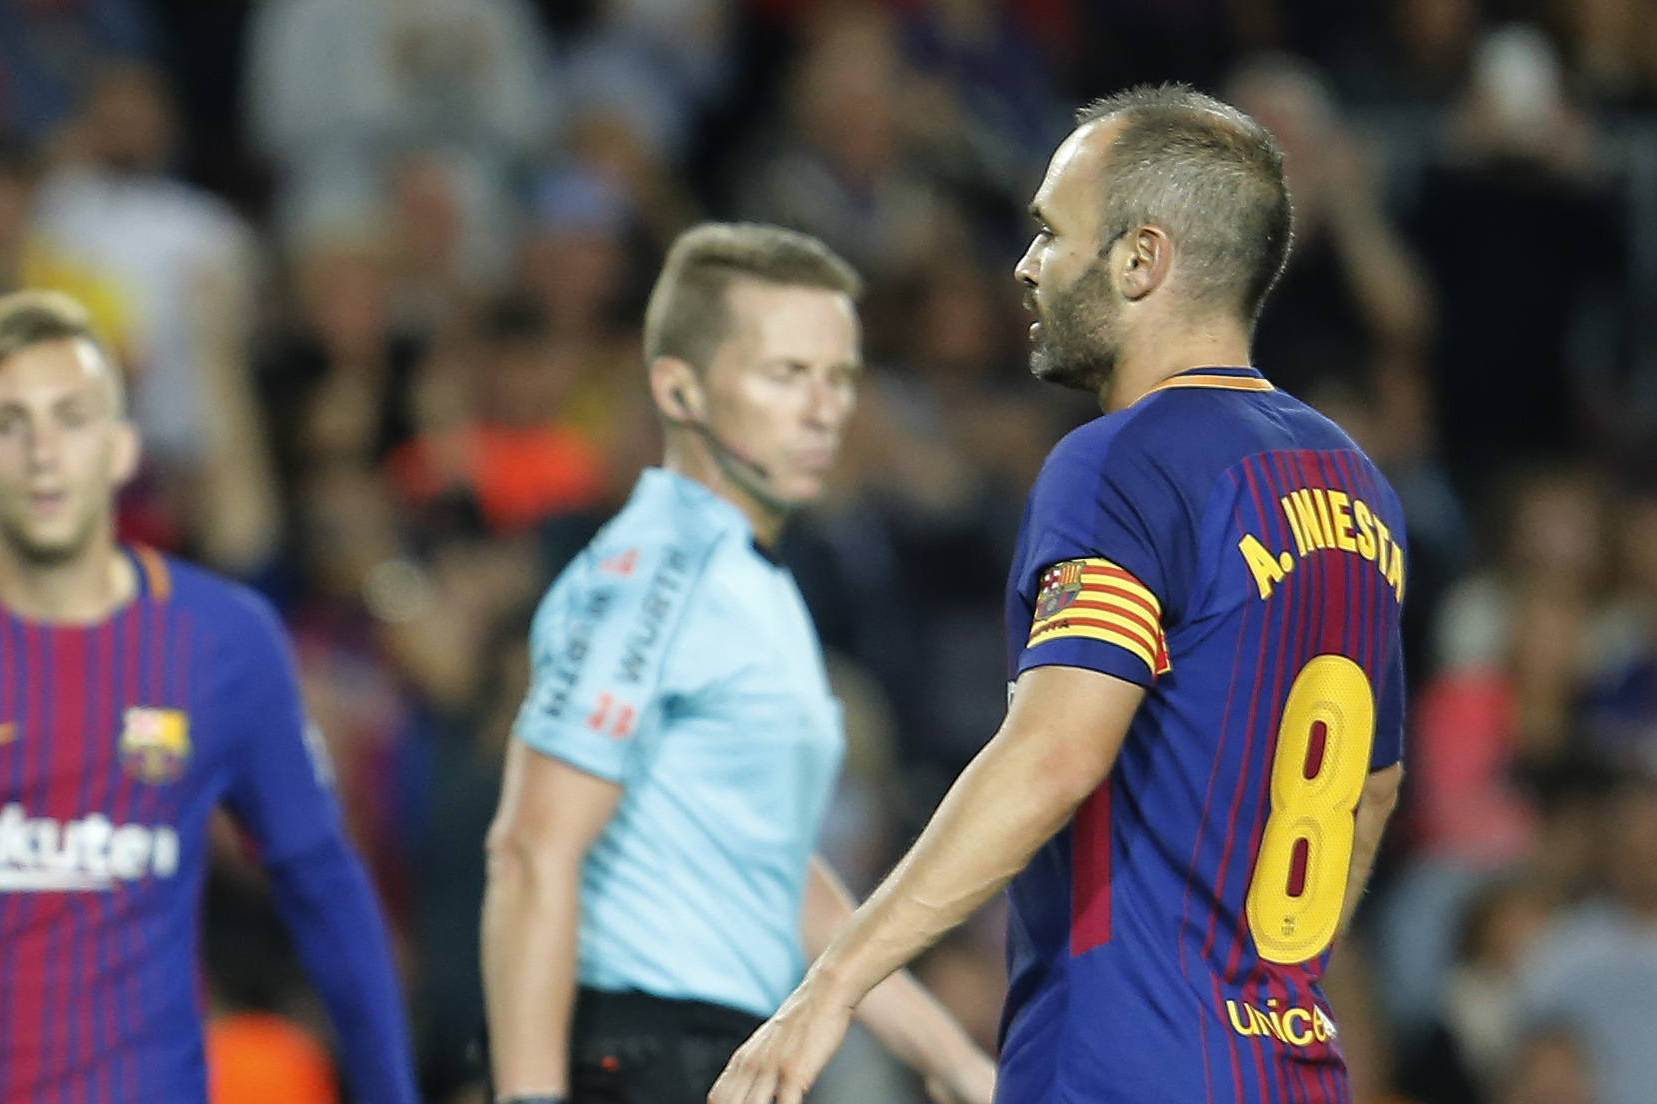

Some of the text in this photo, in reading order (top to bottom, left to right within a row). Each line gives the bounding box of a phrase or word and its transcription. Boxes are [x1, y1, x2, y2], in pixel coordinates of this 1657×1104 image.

[1238, 487, 1406, 604] A. INIESTA
[1246, 653, 1375, 964] 8
[1225, 998, 1337, 1046] unice
